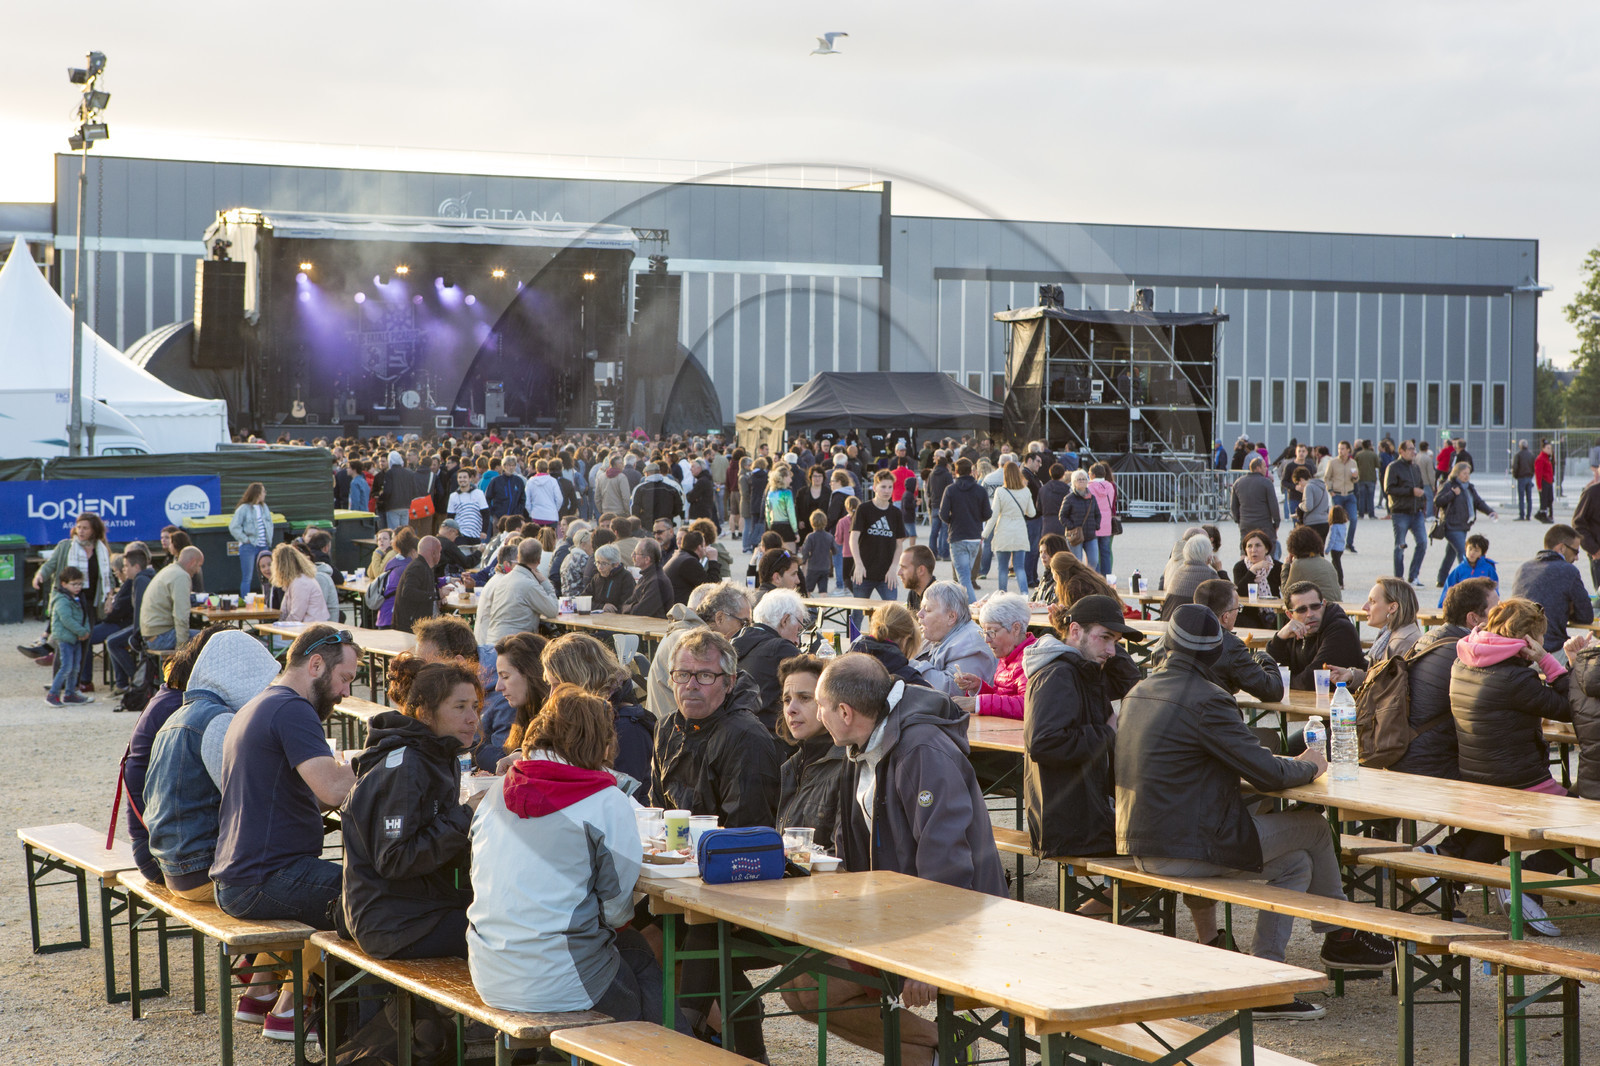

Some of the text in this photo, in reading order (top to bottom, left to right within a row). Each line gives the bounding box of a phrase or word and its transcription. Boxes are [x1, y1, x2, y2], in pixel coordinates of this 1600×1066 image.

[473, 207, 564, 222] GITANA
[867, 528, 893, 537] adidas
[385, 819, 401, 829] HH
